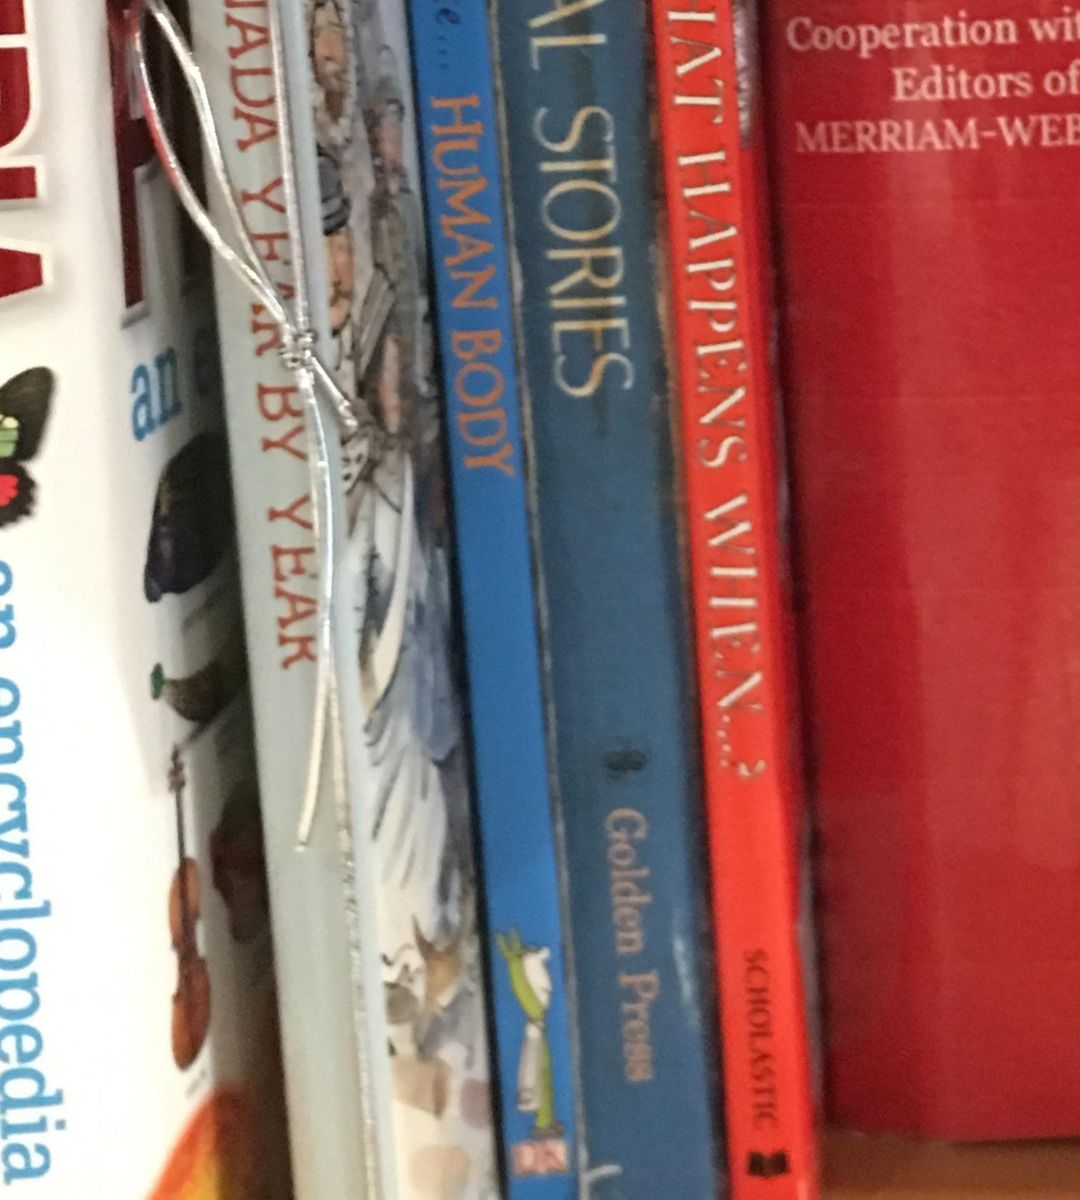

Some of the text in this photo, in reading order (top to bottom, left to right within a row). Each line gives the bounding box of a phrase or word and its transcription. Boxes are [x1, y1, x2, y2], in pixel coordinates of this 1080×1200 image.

[787, 13, 1019, 59] Cooperation
[892, 65, 1034, 102] Editors
[430, 95, 500, 310] HUMAN
[534, 107, 634, 399] STORIES
[676, 151, 750, 470] HAPPENS
[256, 383, 309, 462] BY
[451, 331, 515, 476] BODY
[267, 493, 320, 670] YEAR
[605, 808, 654, 956] Golden
[743, 949, 780, 1131] SCHOLASTIC
